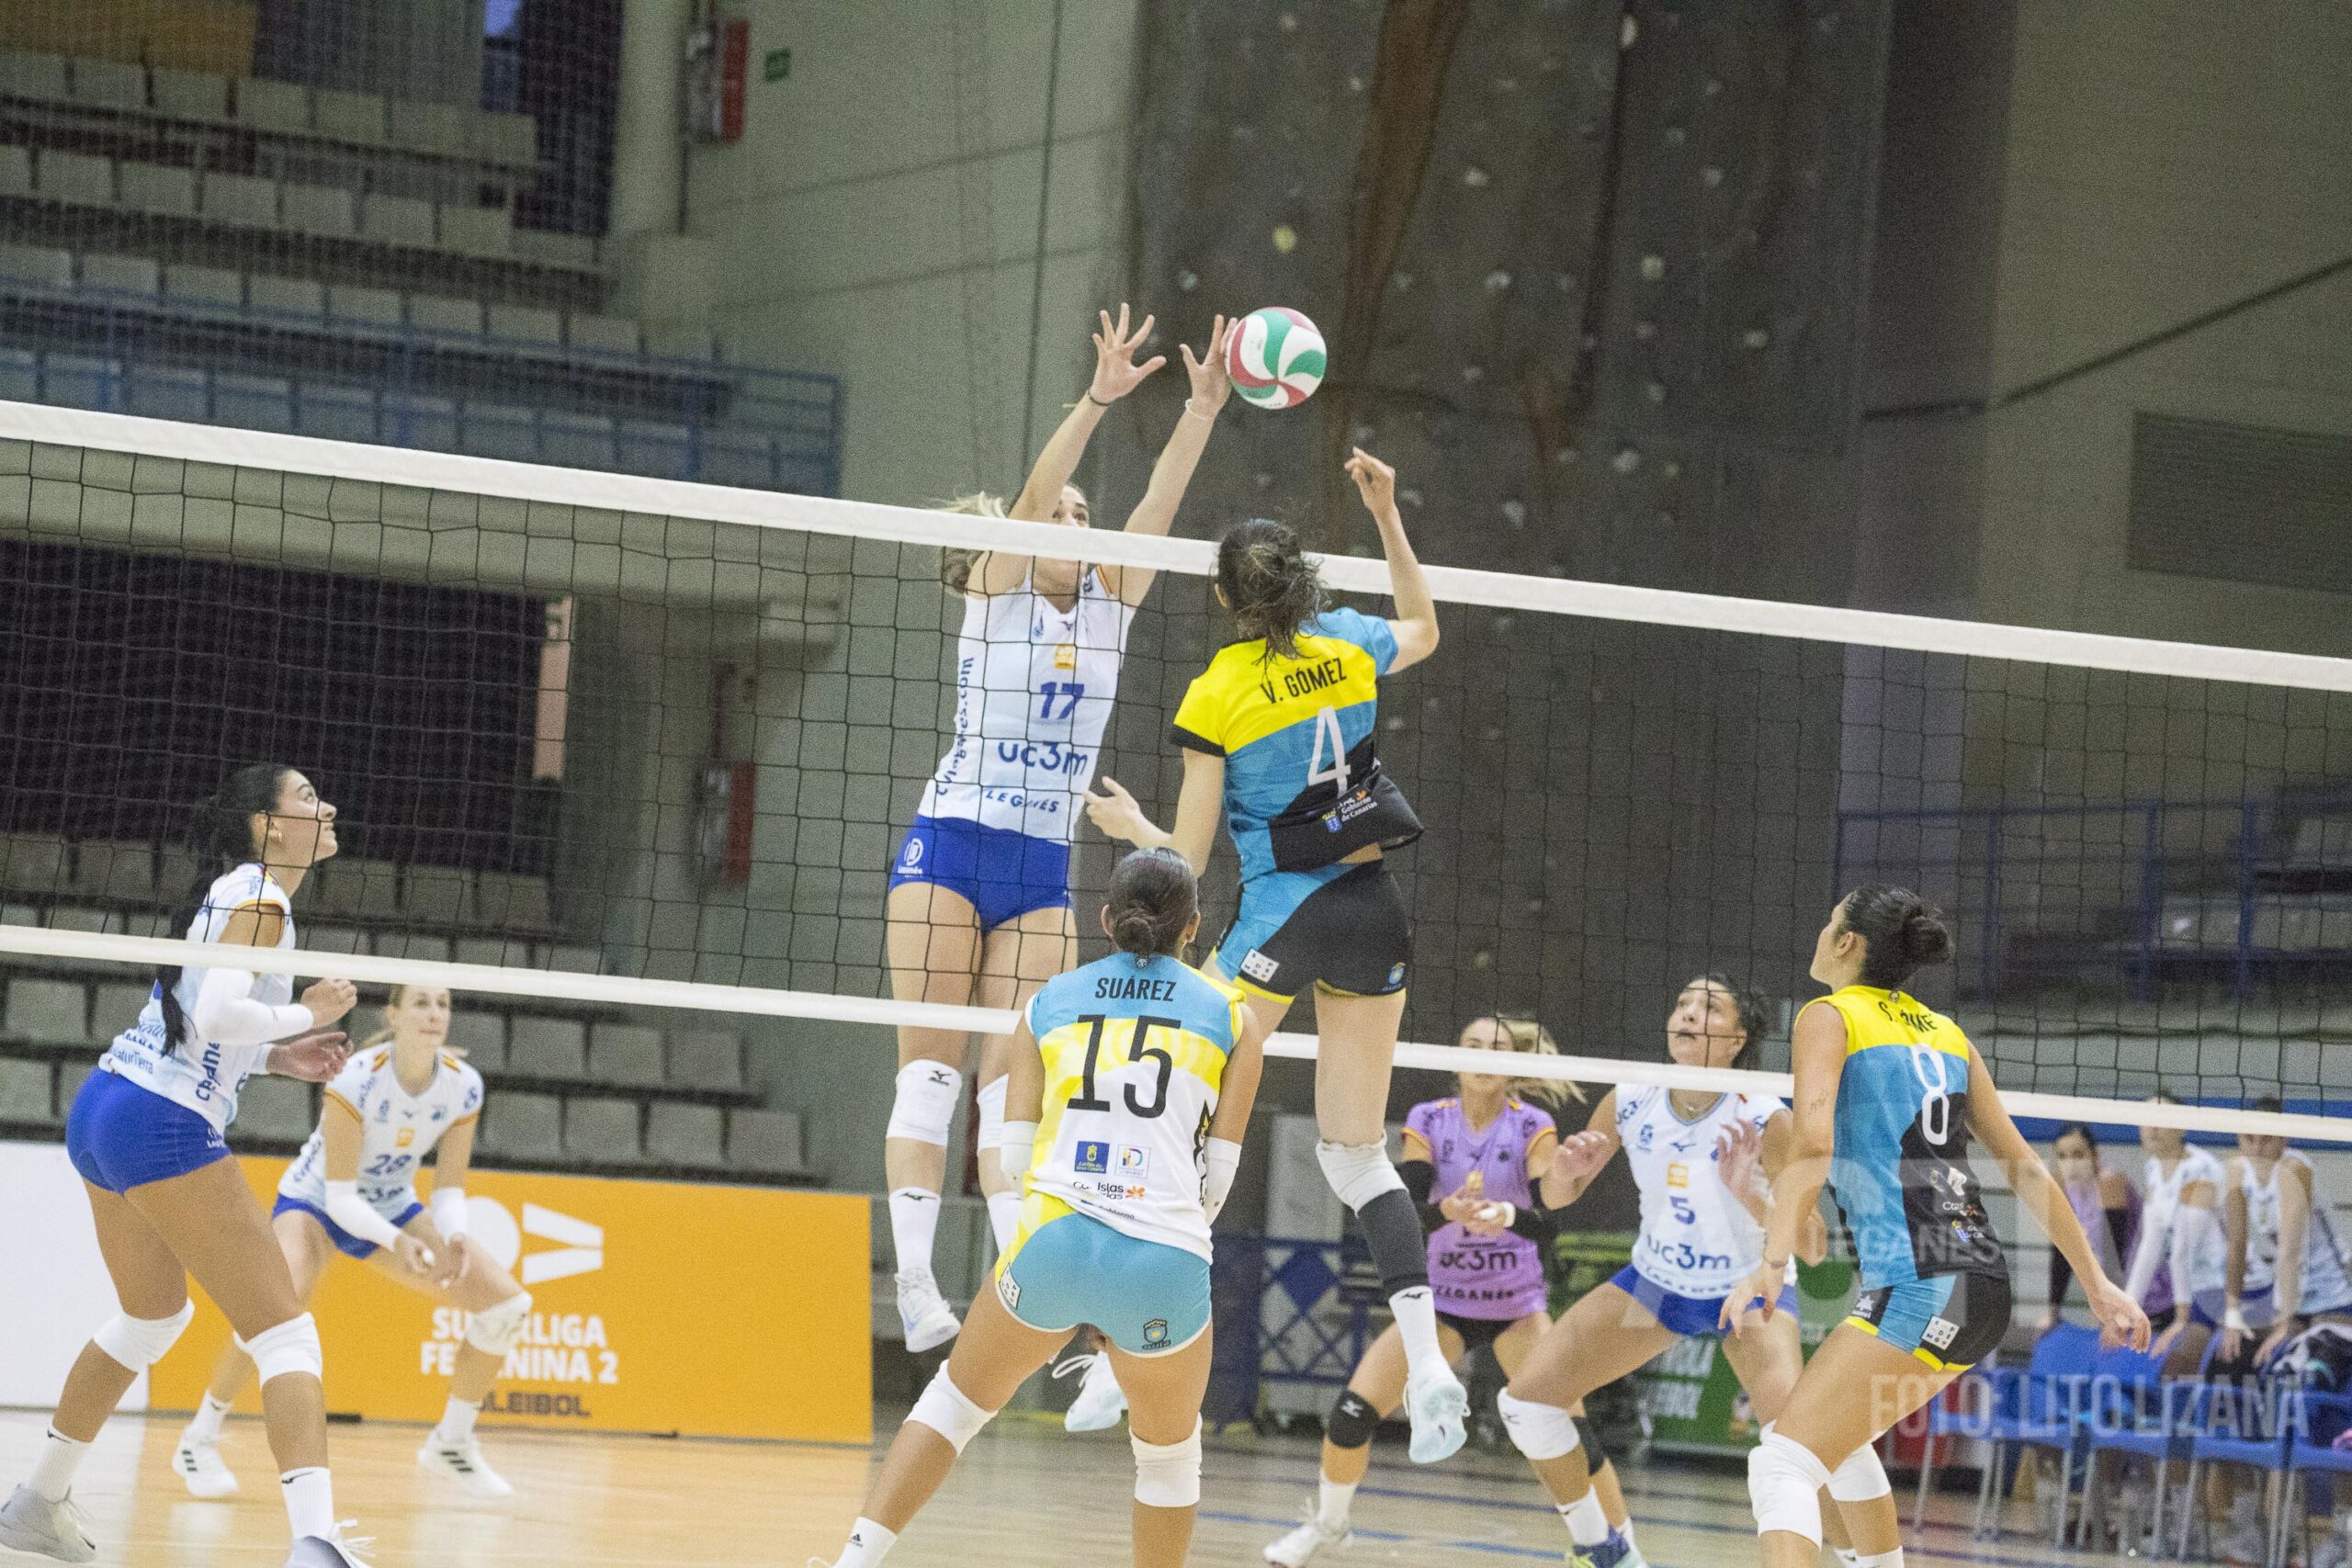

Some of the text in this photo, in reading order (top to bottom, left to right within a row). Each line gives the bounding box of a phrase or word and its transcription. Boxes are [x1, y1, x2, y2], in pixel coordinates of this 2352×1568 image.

[1260, 658, 1347, 704] V. GÓMEZ
[1040, 682, 1085, 719] 17
[998, 740, 1089, 776] uc3m
[1307, 705, 1351, 799] 4
[1094, 974, 1177, 1002] SUÁREZ
[1067, 1014, 1182, 1119] 15
[1911, 1043, 1950, 1145] 8
[1669, 1195, 1696, 1225] 5
[1439, 1250, 1518, 1271] uc3m
[1646, 1233, 1732, 1270] uc3m
[432, 1307, 608, 1348] SULIGA
[420, 1341, 618, 1384] FENINA 2
[481, 1391, 592, 1417] LEIBOL
